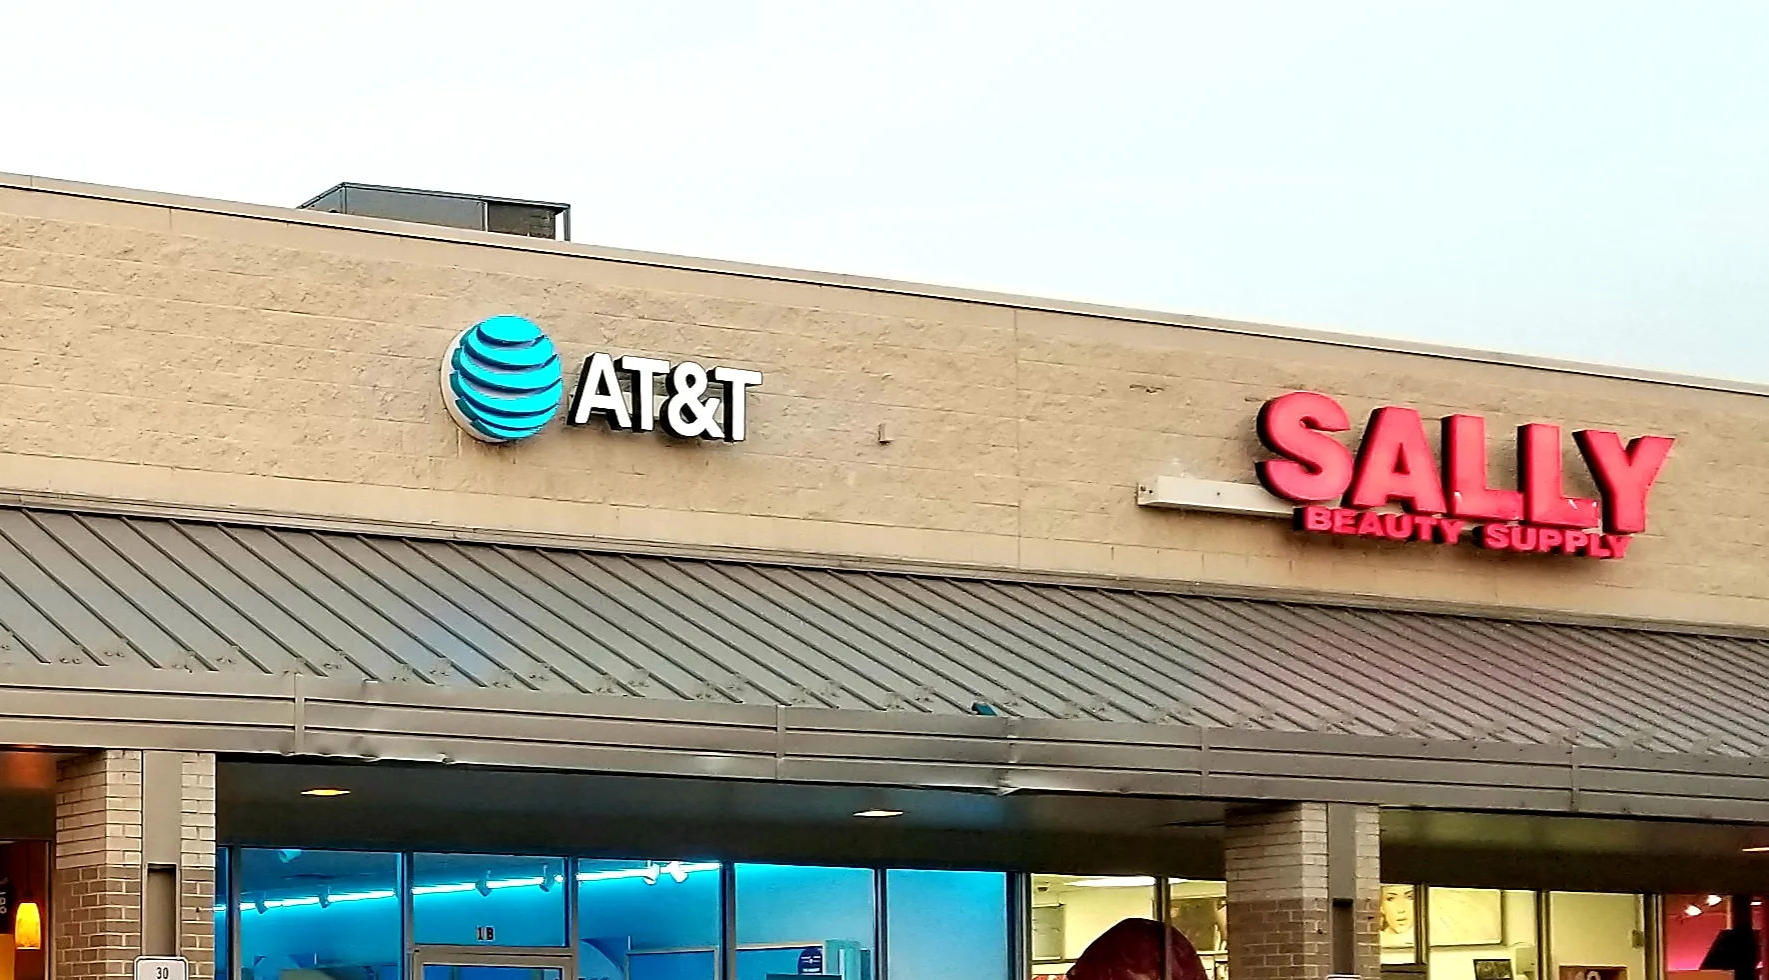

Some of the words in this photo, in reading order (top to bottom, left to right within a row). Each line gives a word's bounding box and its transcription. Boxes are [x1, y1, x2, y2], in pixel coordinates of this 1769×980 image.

[568, 351, 764, 443] AT&T
[1255, 391, 1676, 534] SALLY
[1295, 504, 1467, 545] BEAUTY
[1474, 521, 1633, 560] SUPPLY
[477, 926, 494, 941] 1B
[156, 966, 169, 980] 30
